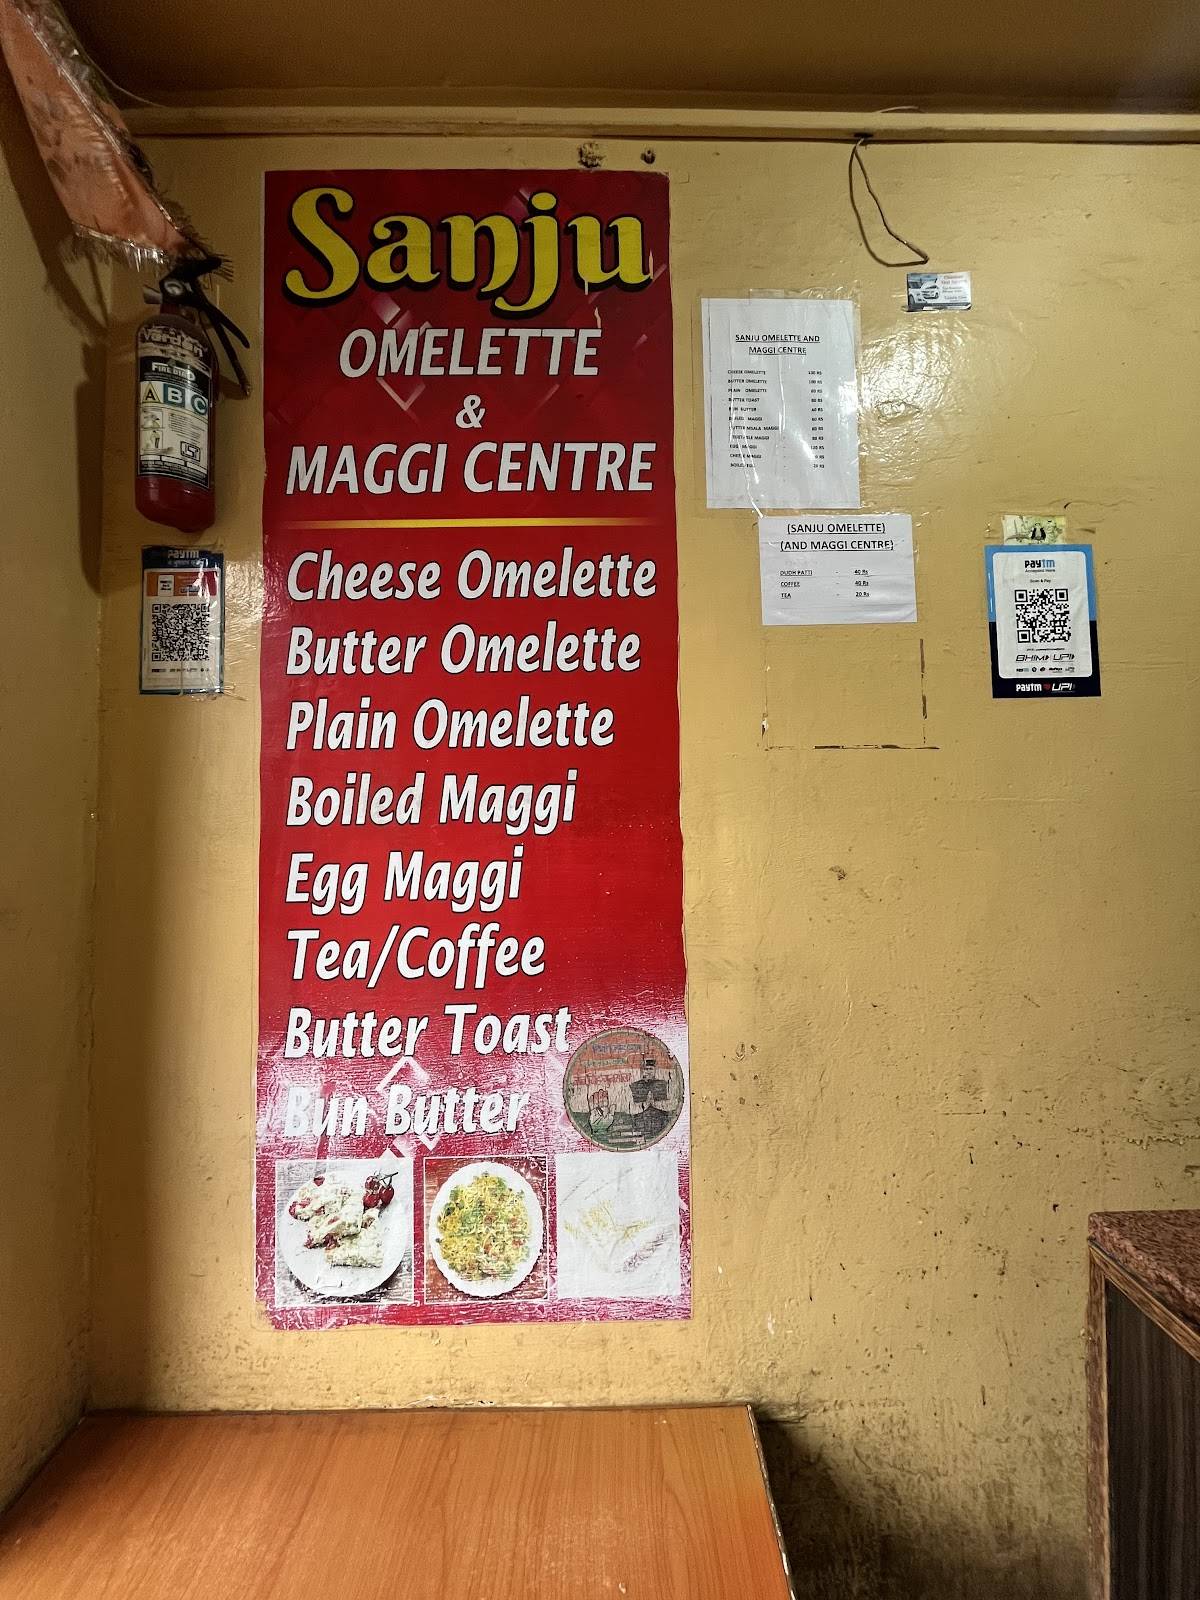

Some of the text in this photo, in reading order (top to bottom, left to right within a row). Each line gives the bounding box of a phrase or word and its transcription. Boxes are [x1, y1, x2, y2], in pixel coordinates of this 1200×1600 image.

[284, 187, 654, 315] Sanju
[339, 327, 602, 378] OMELETTE
[735, 334, 820, 343] SANJU OMELETTE AND
[748, 346, 807, 355] MAGGI CENTRE
[151, 361, 171, 374] FIRE
[145, 388, 157, 401] A
[167, 387, 183, 404] B
[455, 395, 485, 429] &
[286, 442, 657, 495] MAGGI CENTRE
[780, 539, 894, 551] (AND MAGGI CENTRE)
[787, 522, 886, 534] (SANJU OMELETTE)
[287, 546, 657, 601] Cheese Omelette
[286, 620, 641, 676] Butter Omelette
[1015, 682, 1073, 692] paytm UPI
[286, 695, 615, 751] Plain Omelette
[286, 769, 578, 835] Boiled Maggi
[285, 846, 524, 915] Egg Maggi
[286, 922, 546, 989] Tea/Coffee
[284, 1004, 572, 1059] Butter Toast
[284, 1084, 530, 1138] Bun Butter
